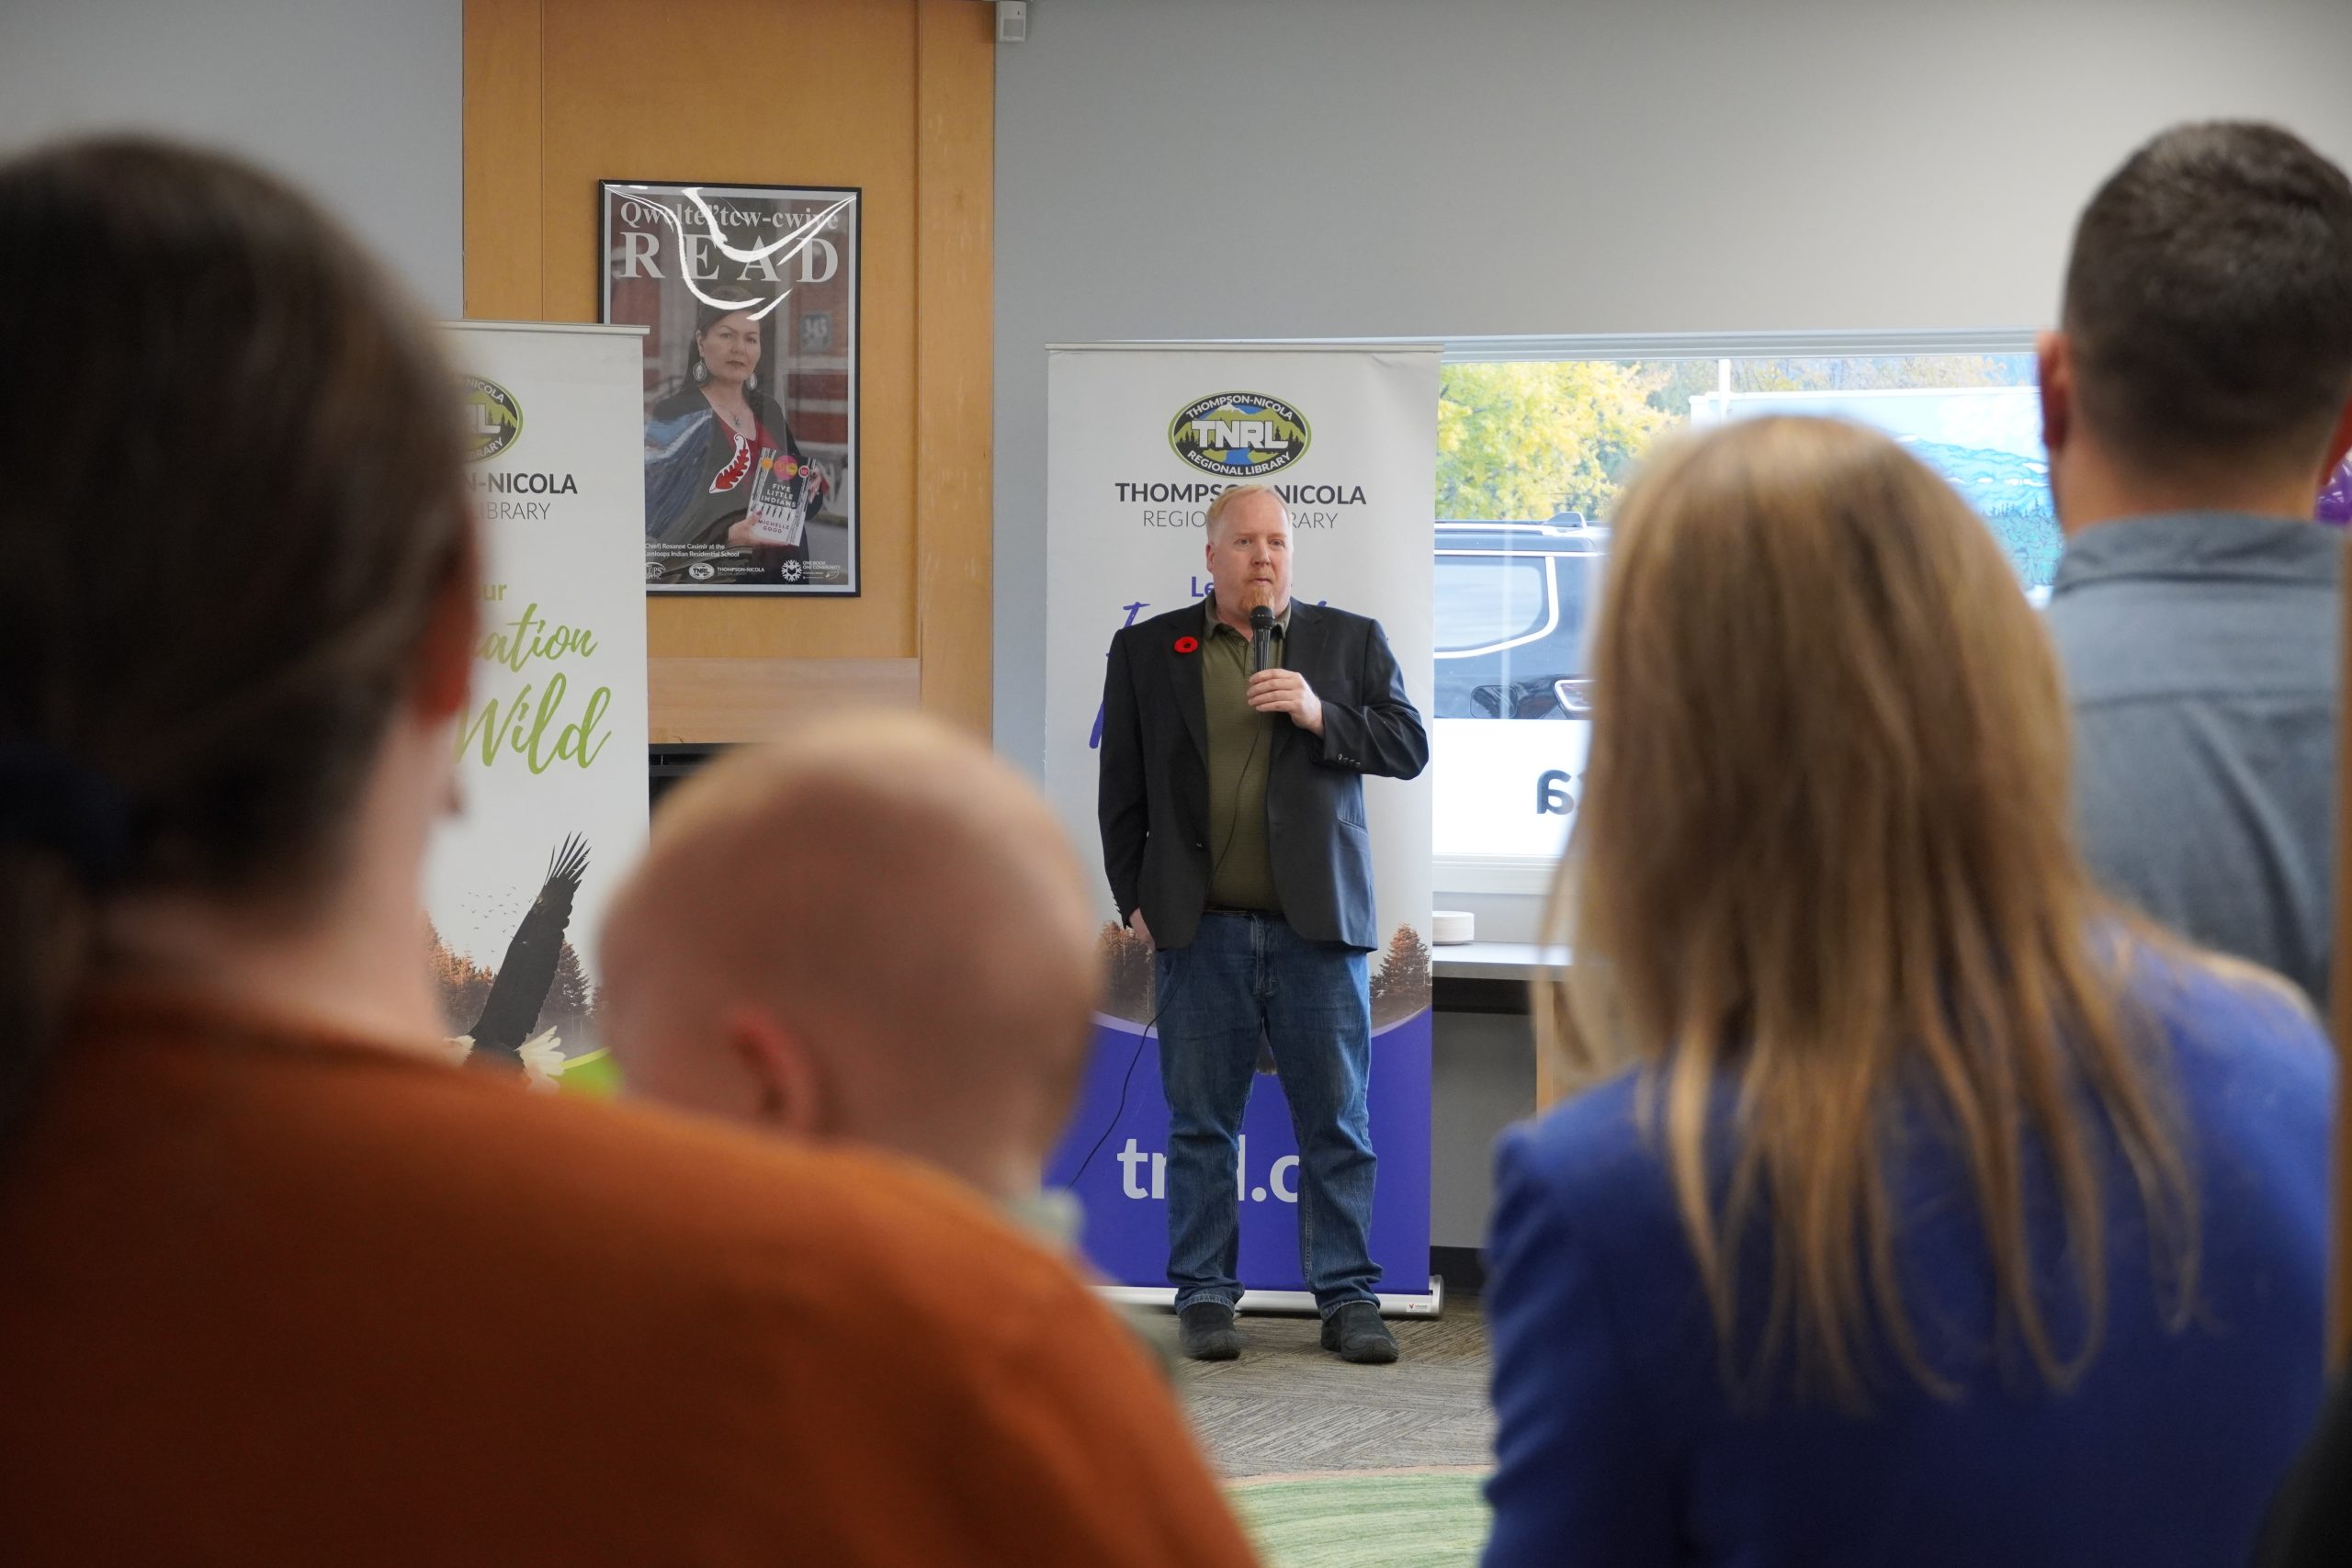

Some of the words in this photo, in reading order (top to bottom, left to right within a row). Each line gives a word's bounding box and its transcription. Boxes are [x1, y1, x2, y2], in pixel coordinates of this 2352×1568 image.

[619, 231, 839, 283] READ
[1186, 395, 1294, 421] THOMPSON-NICOLA
[1191, 420, 1288, 449] TNRL
[1187, 450, 1243, 476] REGIONAL
[1245, 452, 1291, 476] LIBRARY
[766, 490, 794, 501] LITTLE
[773, 483, 790, 492] FIVE
[761, 496, 797, 508] INDIANS
[758, 519, 790, 530] MICHELLE
[1143, 510, 1207, 527] REGIO
[1291, 512, 1339, 529] RARY
[763, 525, 783, 534] GOOD
[455, 672, 612, 774] Wild
